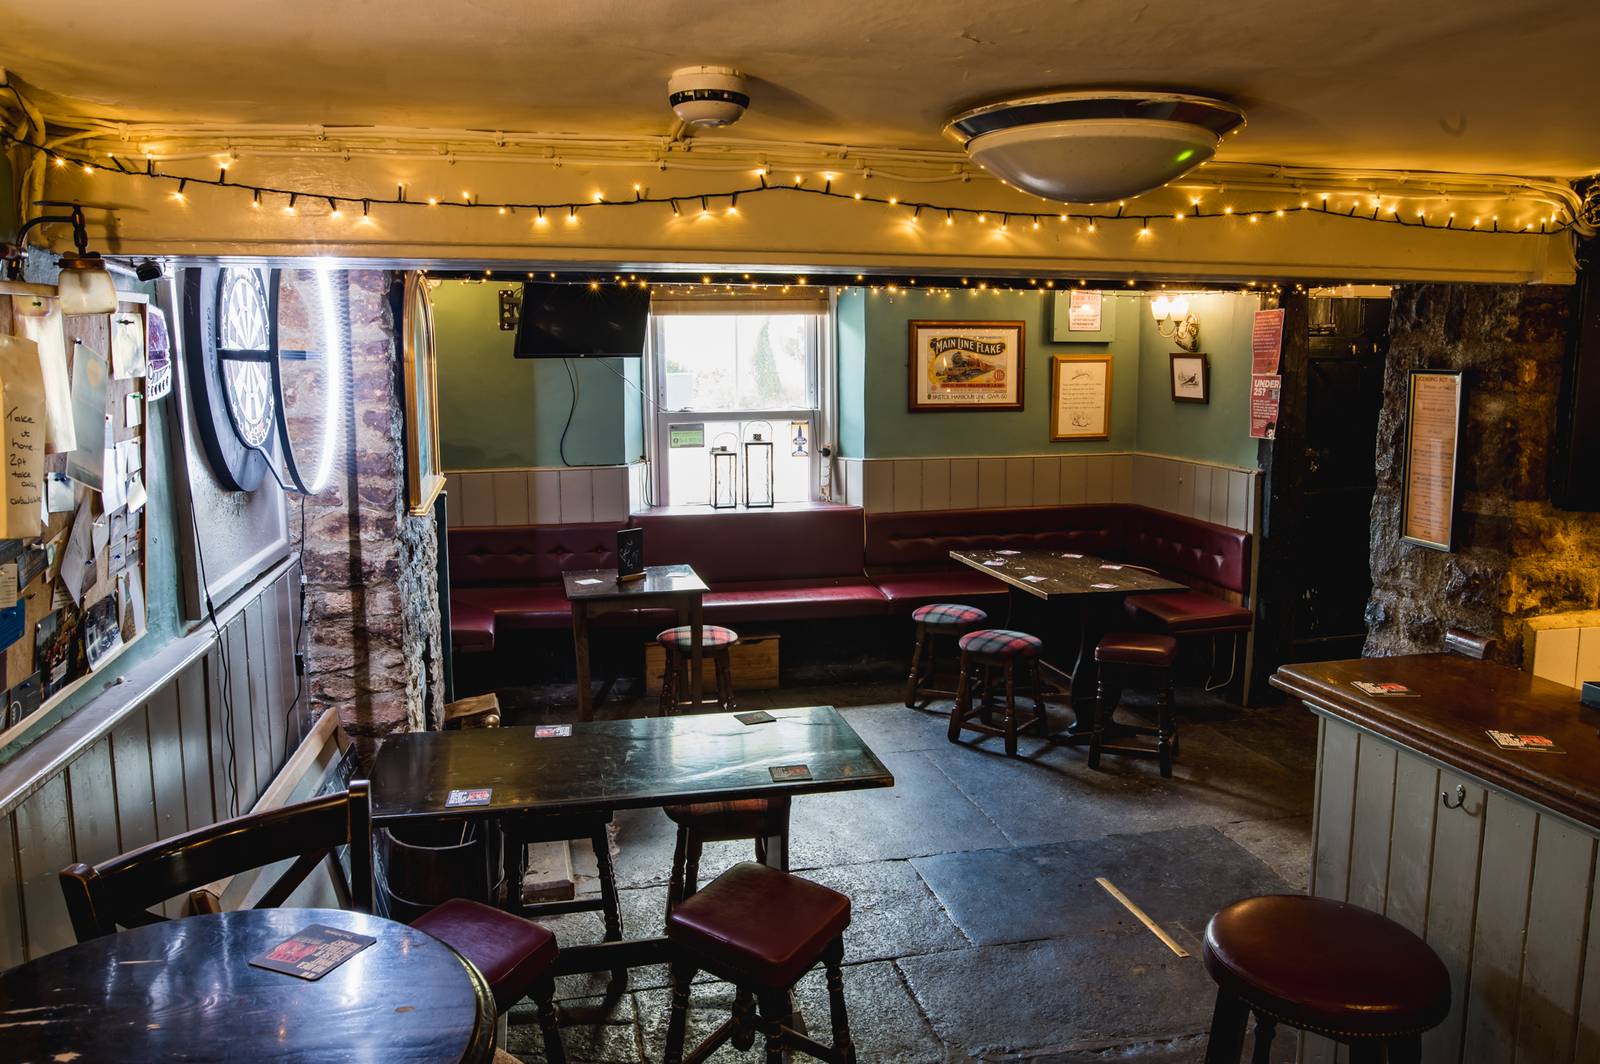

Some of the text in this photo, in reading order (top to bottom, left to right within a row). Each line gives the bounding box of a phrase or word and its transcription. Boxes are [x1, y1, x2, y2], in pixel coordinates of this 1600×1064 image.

[936, 338, 1001, 354] MAIN LINE FLAKE
[1254, 379, 1280, 389] UNDER
[1253, 387, 1267, 397] 25?
[7, 406, 35, 423] Take
